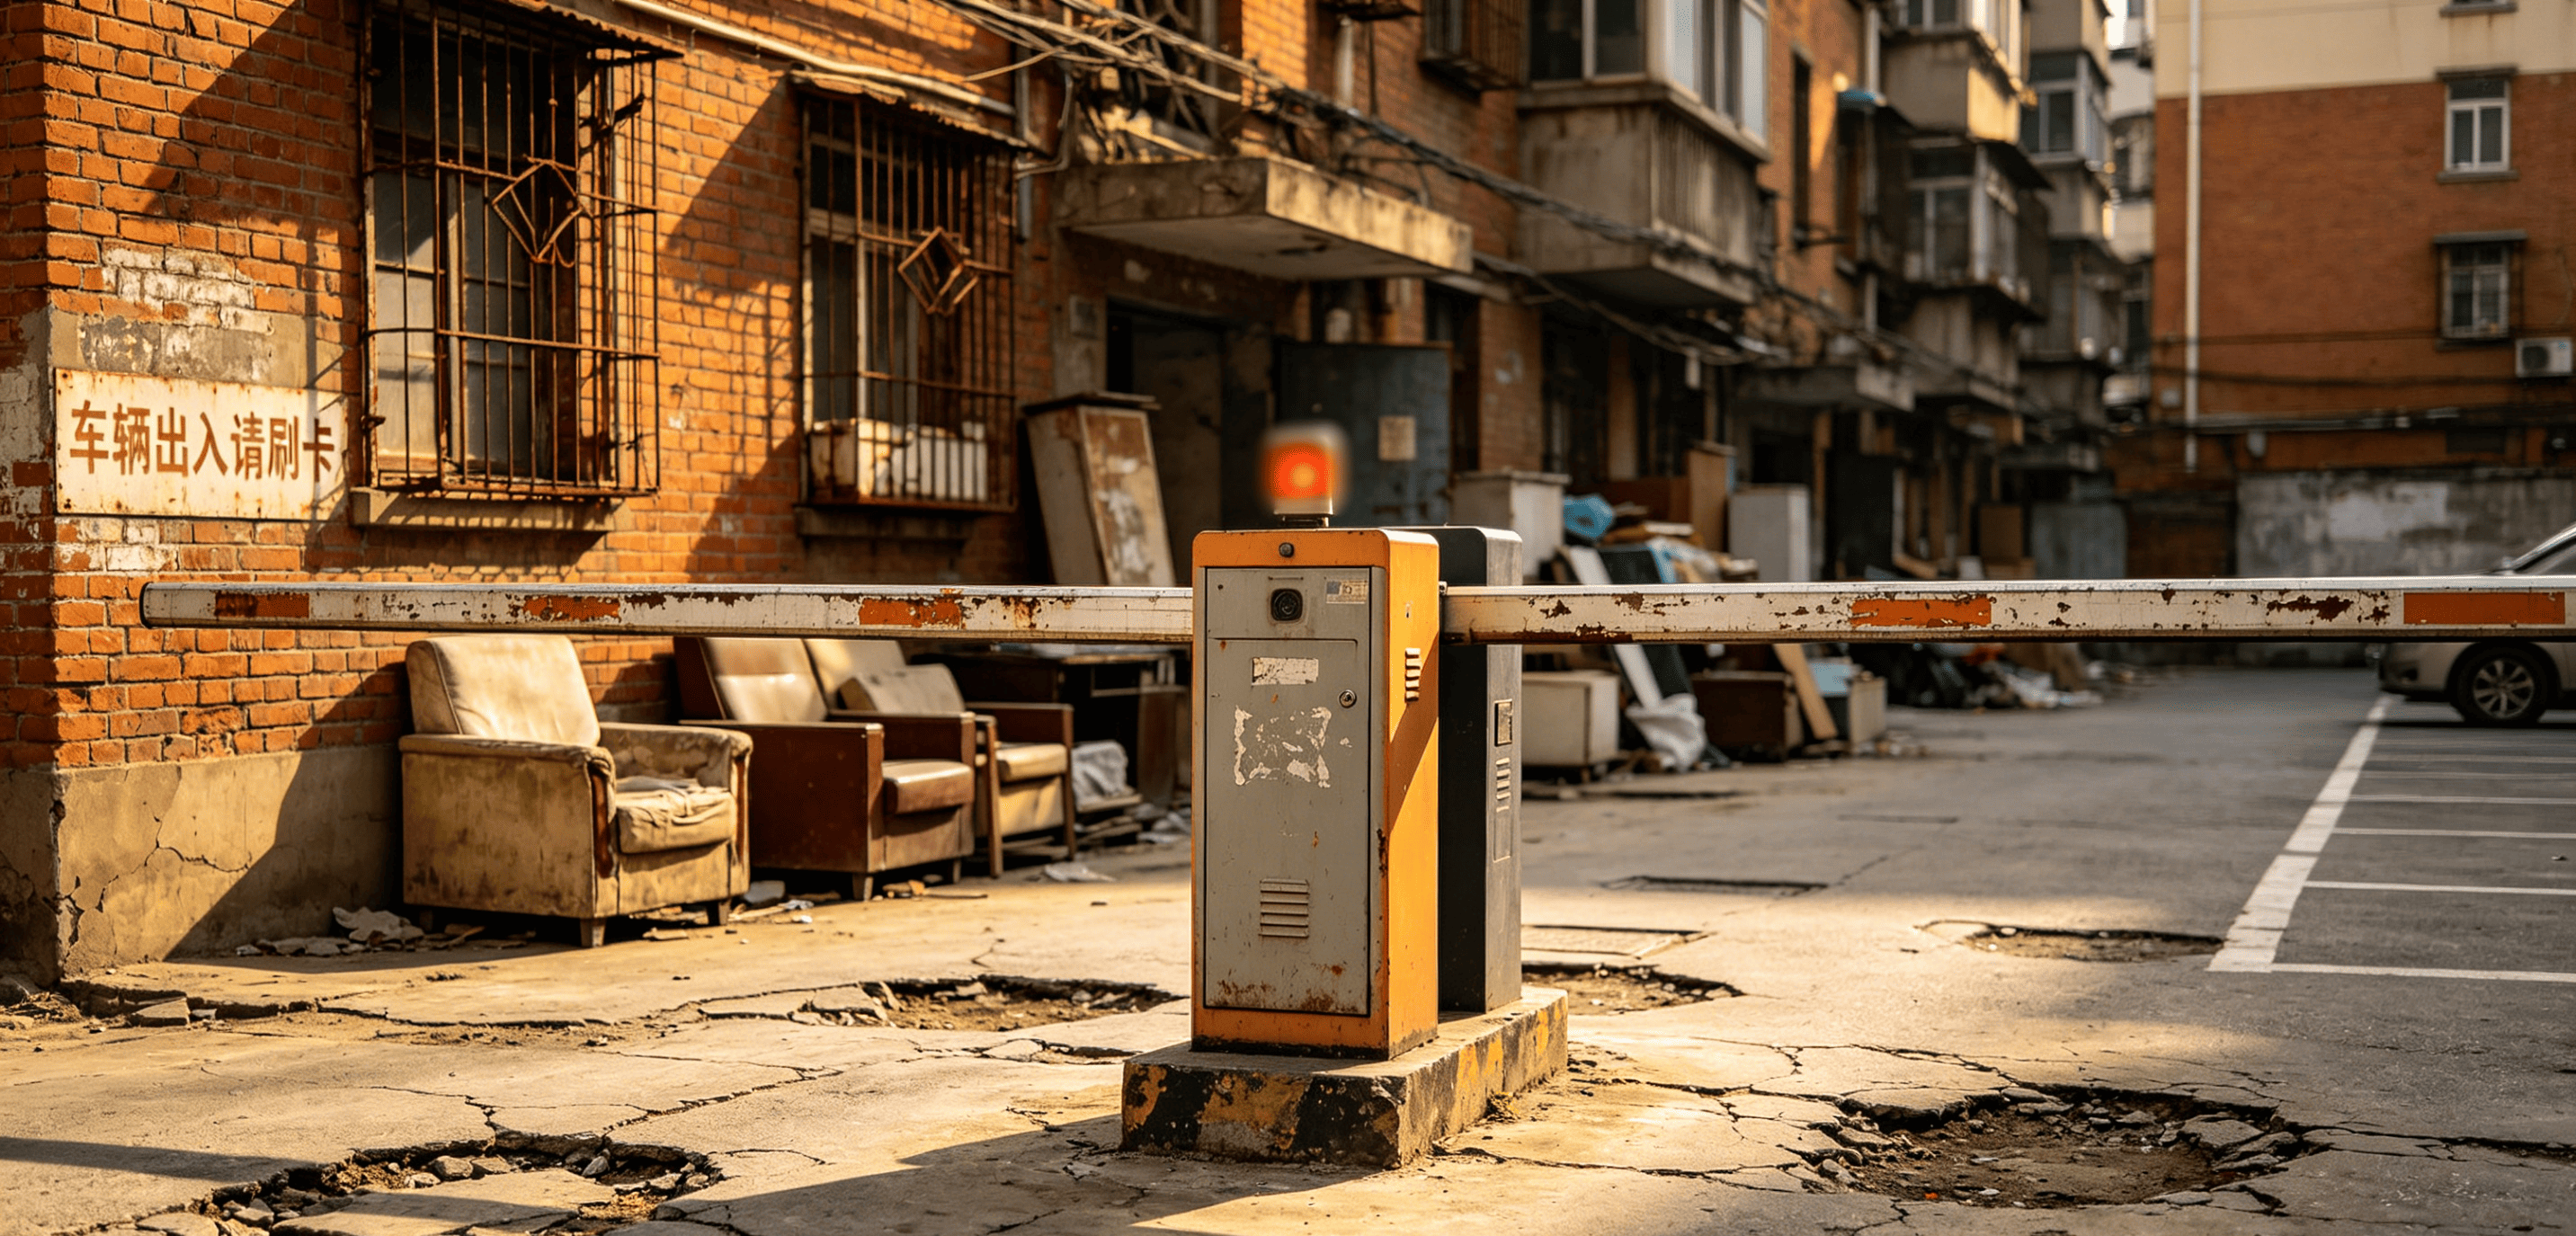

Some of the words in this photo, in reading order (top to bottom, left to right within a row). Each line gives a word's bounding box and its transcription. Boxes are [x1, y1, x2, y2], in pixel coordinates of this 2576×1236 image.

[69, 399, 334, 483] 车辆出入请刷卡
